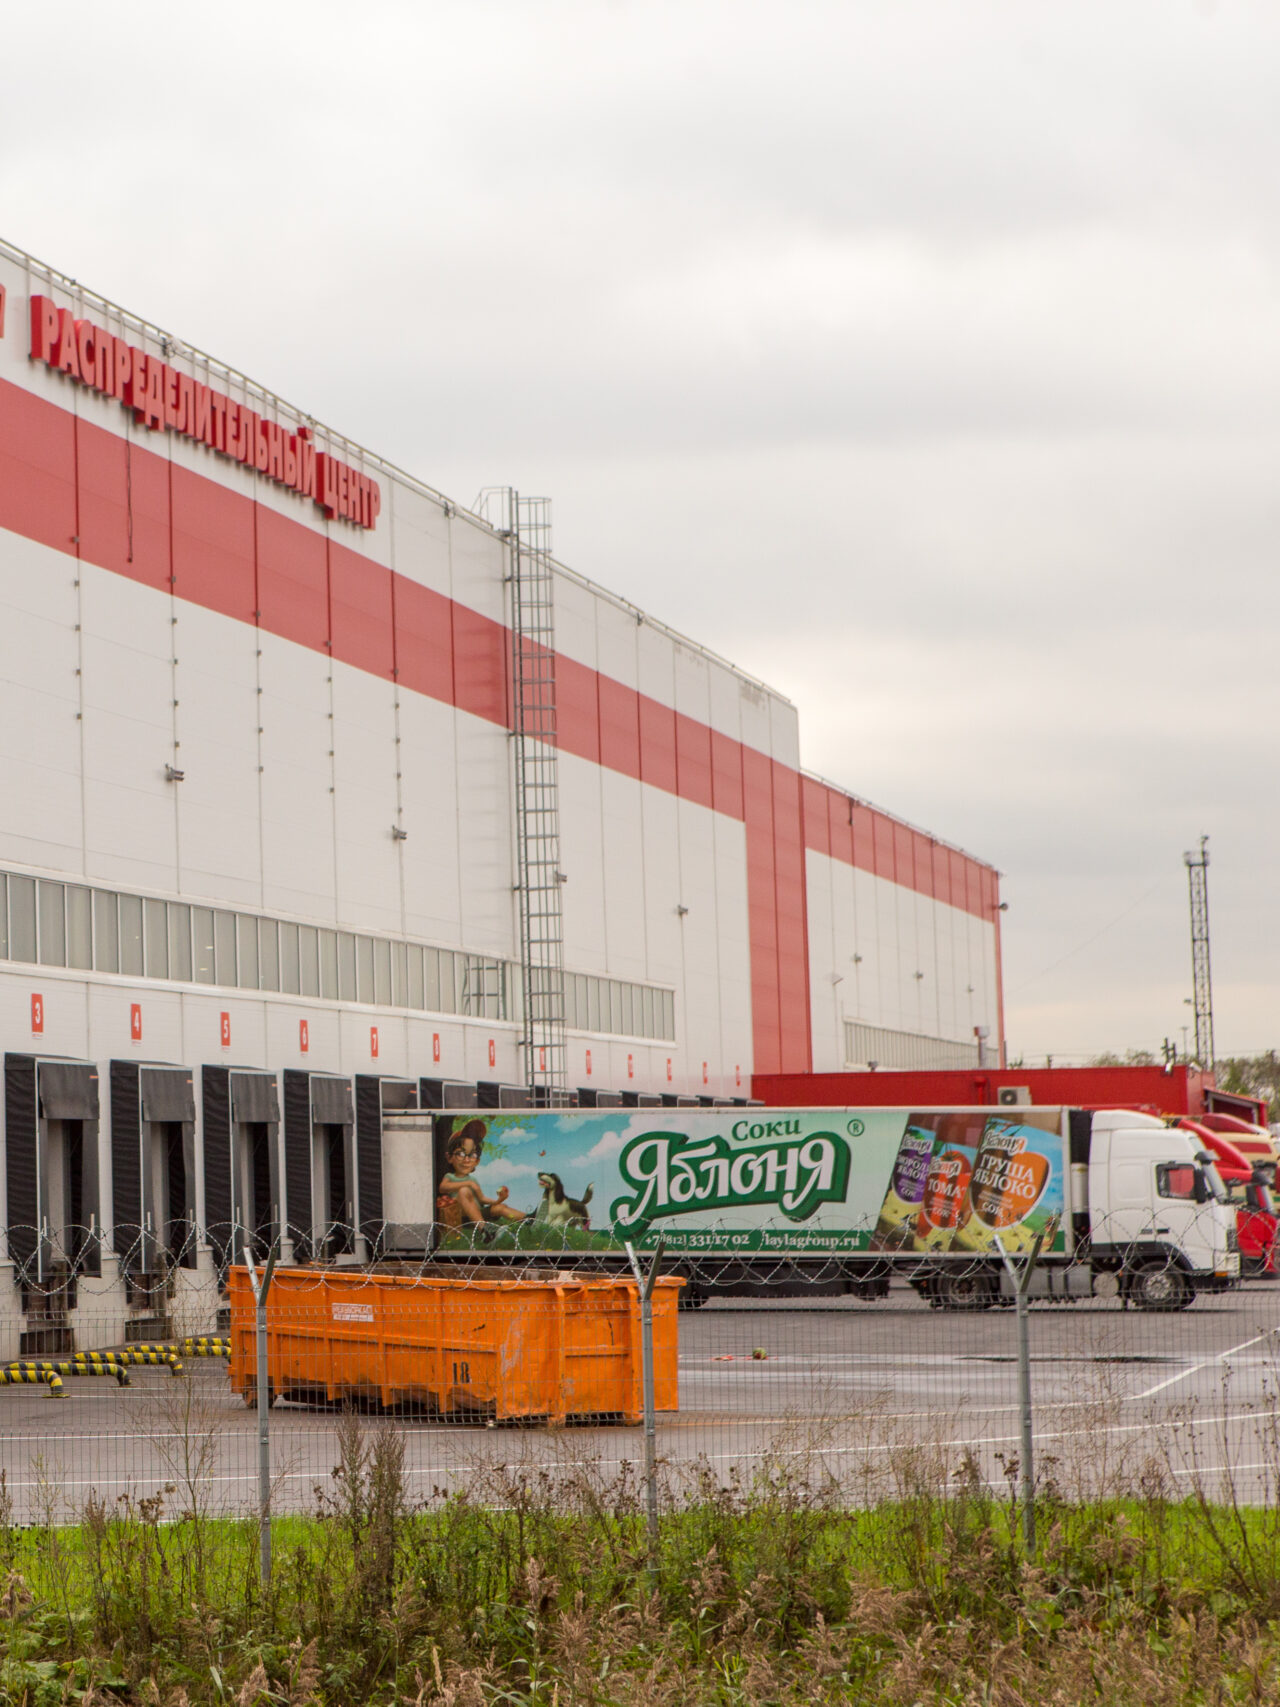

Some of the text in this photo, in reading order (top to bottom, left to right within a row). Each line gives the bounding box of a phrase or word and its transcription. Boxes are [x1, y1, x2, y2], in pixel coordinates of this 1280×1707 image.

[29, 294, 316, 498] РАСПРЕДЕЛИТЕЛЬНЫЙ
[314, 451, 381, 530] ЦЕНТР
[731, 1118, 801, 1141] Соки
[616, 1137, 836, 1227] Яблоня
[980, 1154, 1034, 1183] ГРУША
[973, 1168, 1036, 1199] ЯБЛОКО
[732, 1235, 750, 1245] 02
[765, 1233, 860, 1248] laylagroup.ru
